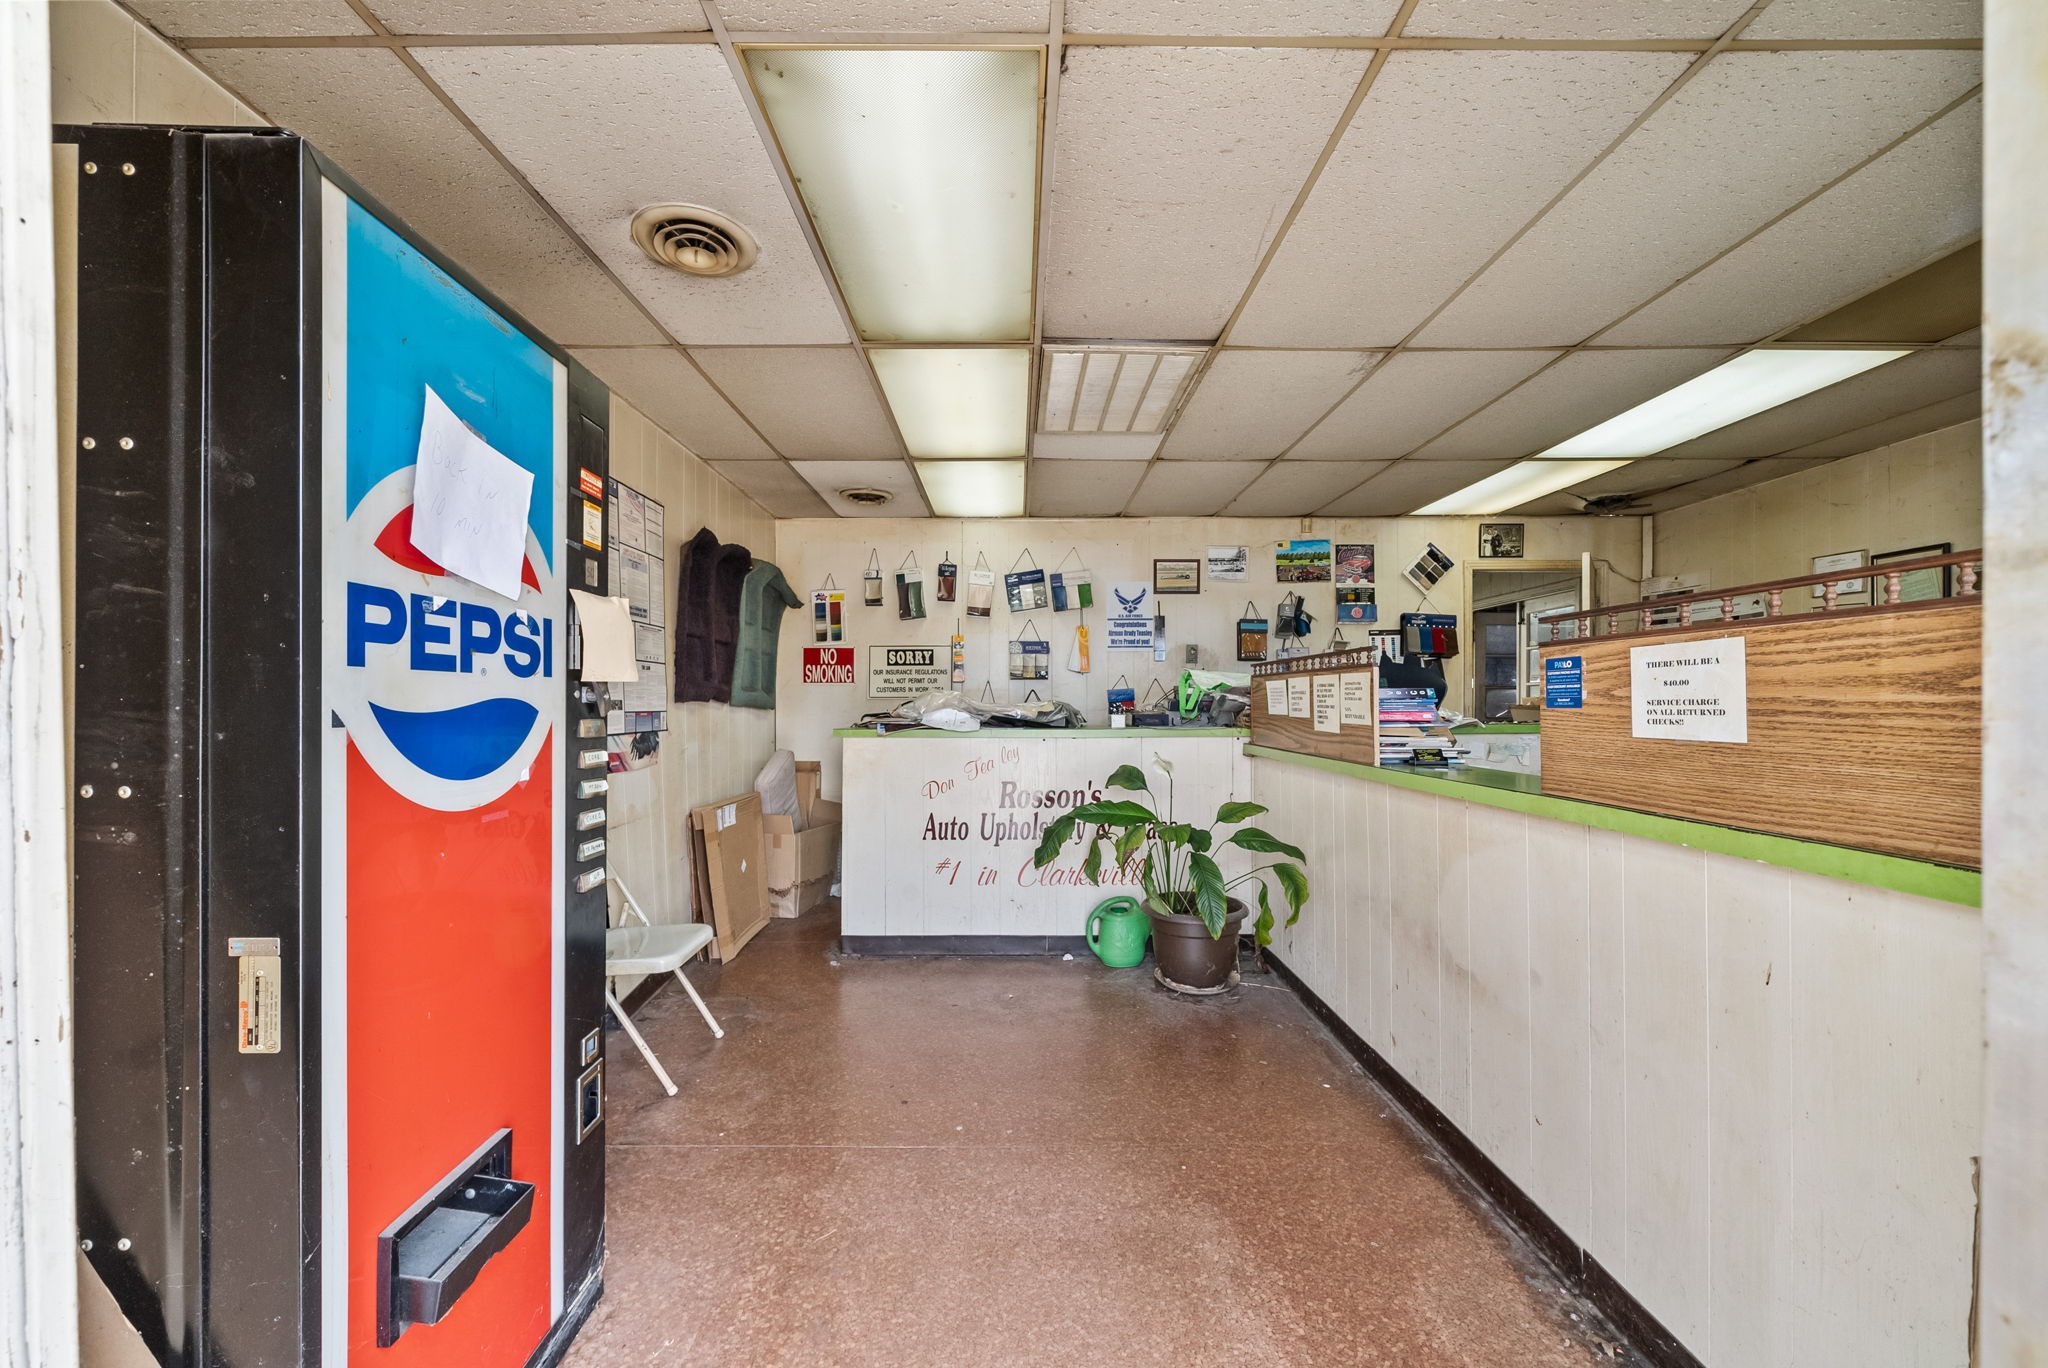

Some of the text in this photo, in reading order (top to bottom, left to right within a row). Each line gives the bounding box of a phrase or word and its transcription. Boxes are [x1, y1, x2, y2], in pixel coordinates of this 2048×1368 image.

[347, 581, 553, 678] PEPSI
[820, 648, 837, 664] NO
[888, 651, 932, 665] SORRY
[1646, 660, 1675, 669] THERE
[805, 665, 853, 683] SMOKING
[1663, 679, 1690, 687] $40.00
[1682, 698, 1720, 706] CHARGE
[1646, 718, 1684, 726] CHECKS!!
[920, 779, 955, 800] Don
[999, 780, 1103, 809] Rosson's
[922, 812, 969, 841] Auto
[935, 857, 962, 886] #1
[977, 865, 998, 886] in
